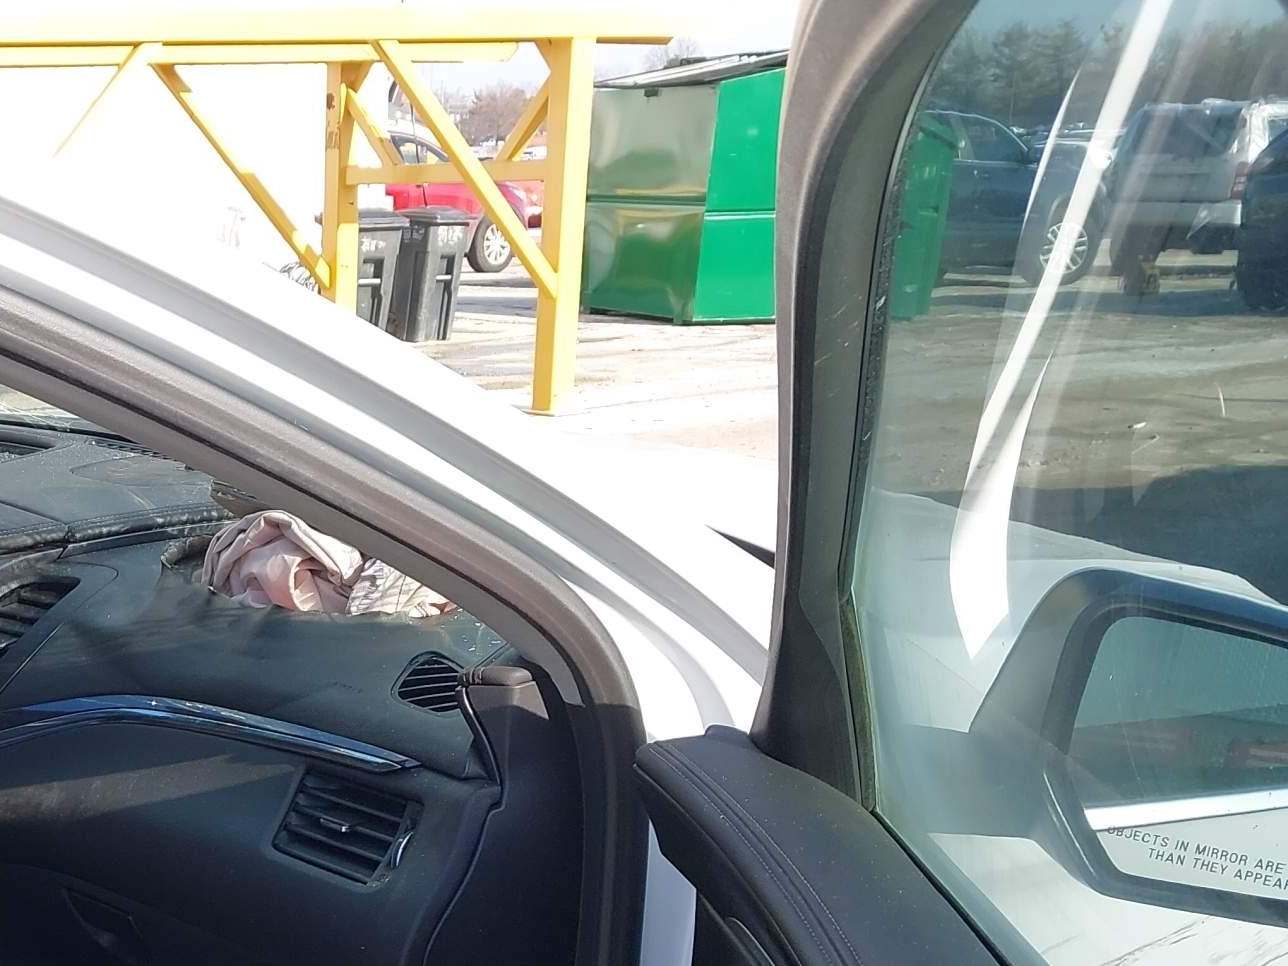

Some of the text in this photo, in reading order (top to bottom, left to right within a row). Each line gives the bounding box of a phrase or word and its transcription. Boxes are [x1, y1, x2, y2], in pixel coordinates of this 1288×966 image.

[1107, 827, 1286, 875] OBJECTS IN MIRROR ARE
[1148, 847, 1186, 866] THAN
[1192, 857, 1229, 876] THEY
